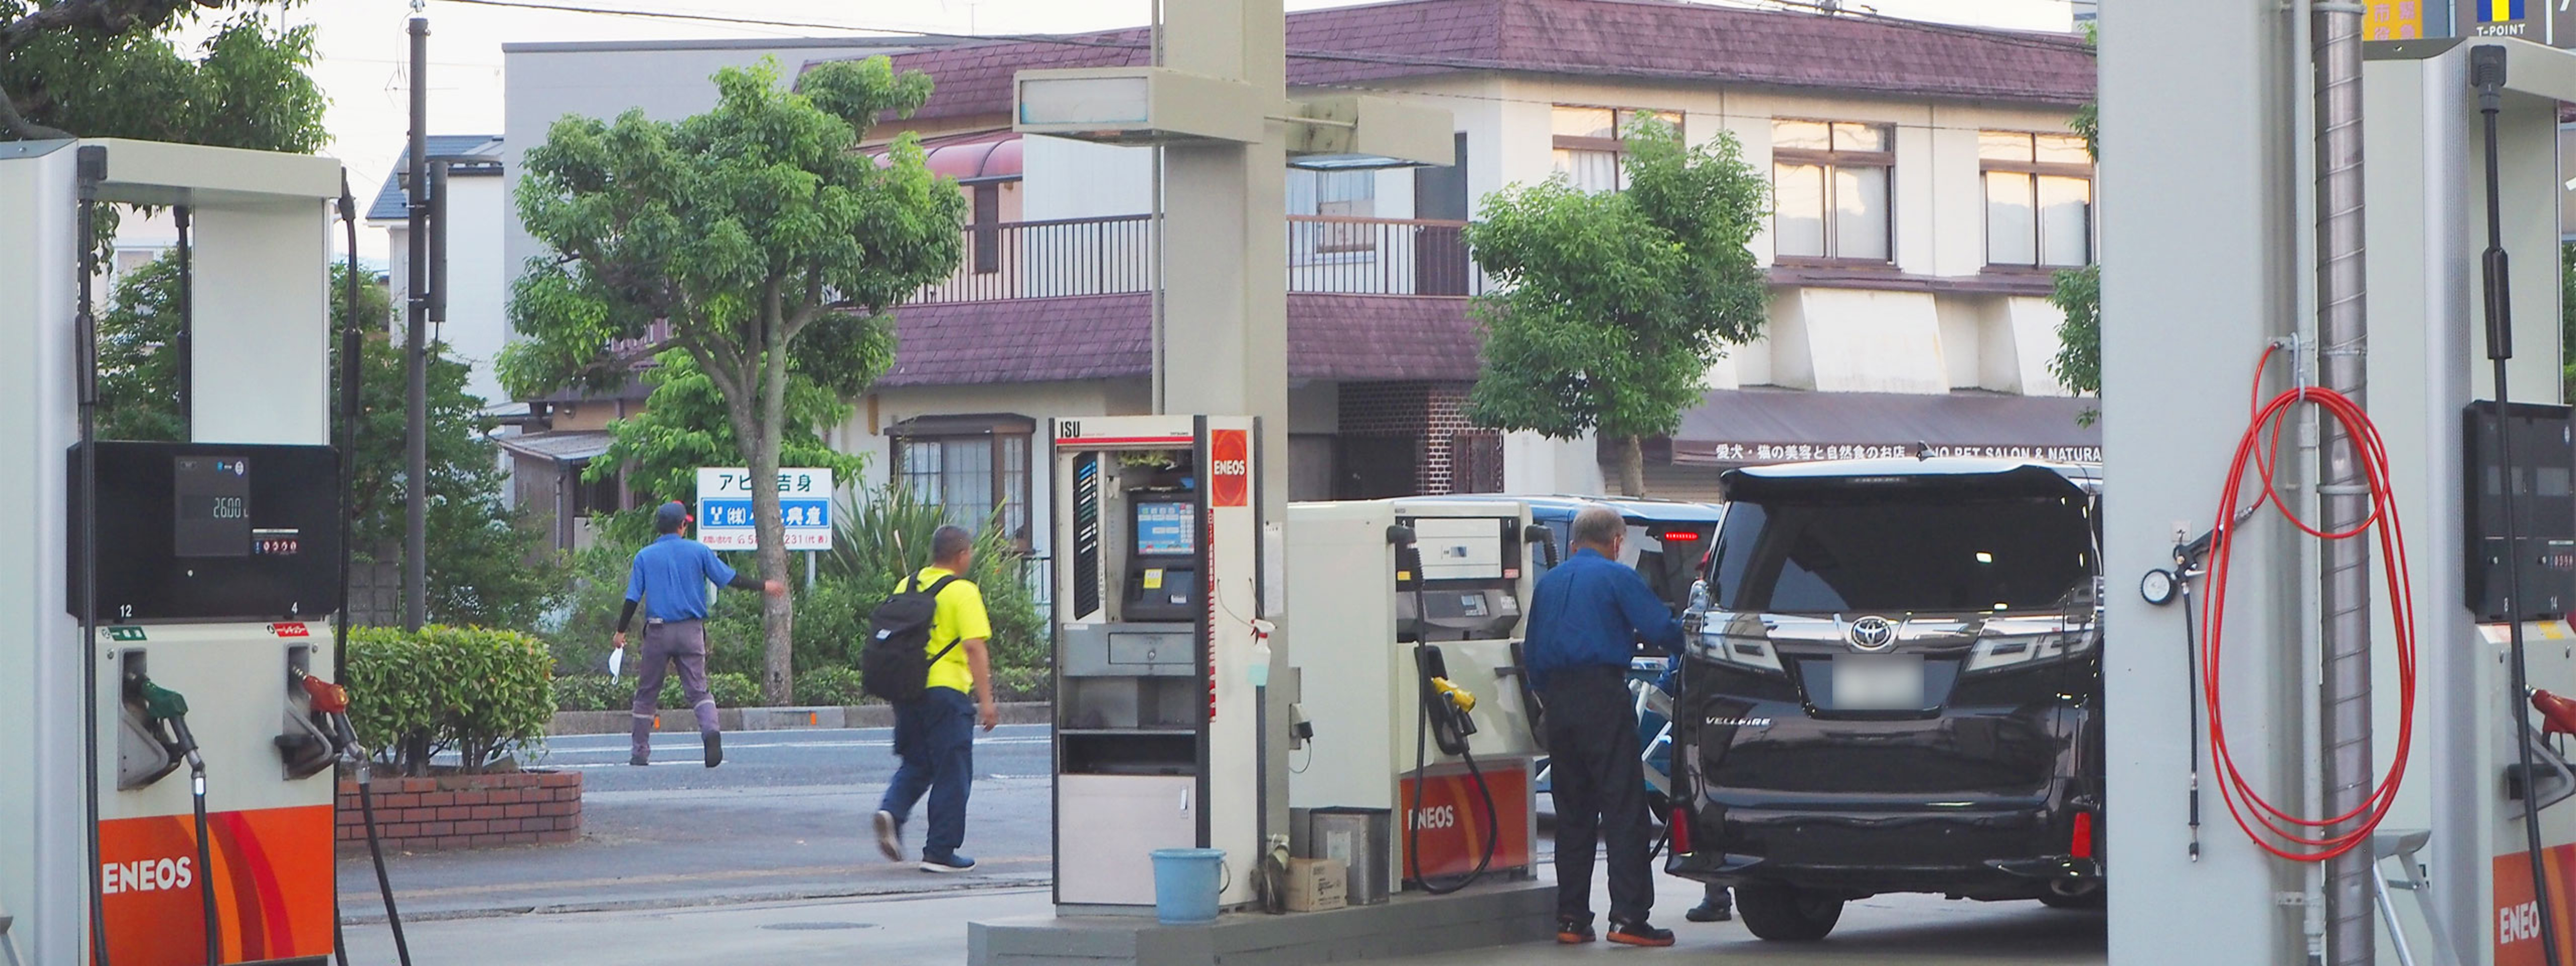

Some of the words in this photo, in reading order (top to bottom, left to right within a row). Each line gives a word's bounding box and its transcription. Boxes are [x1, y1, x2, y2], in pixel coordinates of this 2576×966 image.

[2476, 24, 2526, 37] T-POINT
[1060, 421, 1081, 438] ISU
[1985, 446, 2030, 458] SALON
[1214, 459, 1246, 476] ENEOS
[120, 604, 132, 617] 12
[291, 601, 298, 614] 4
[102, 856, 192, 894] ENEOS
